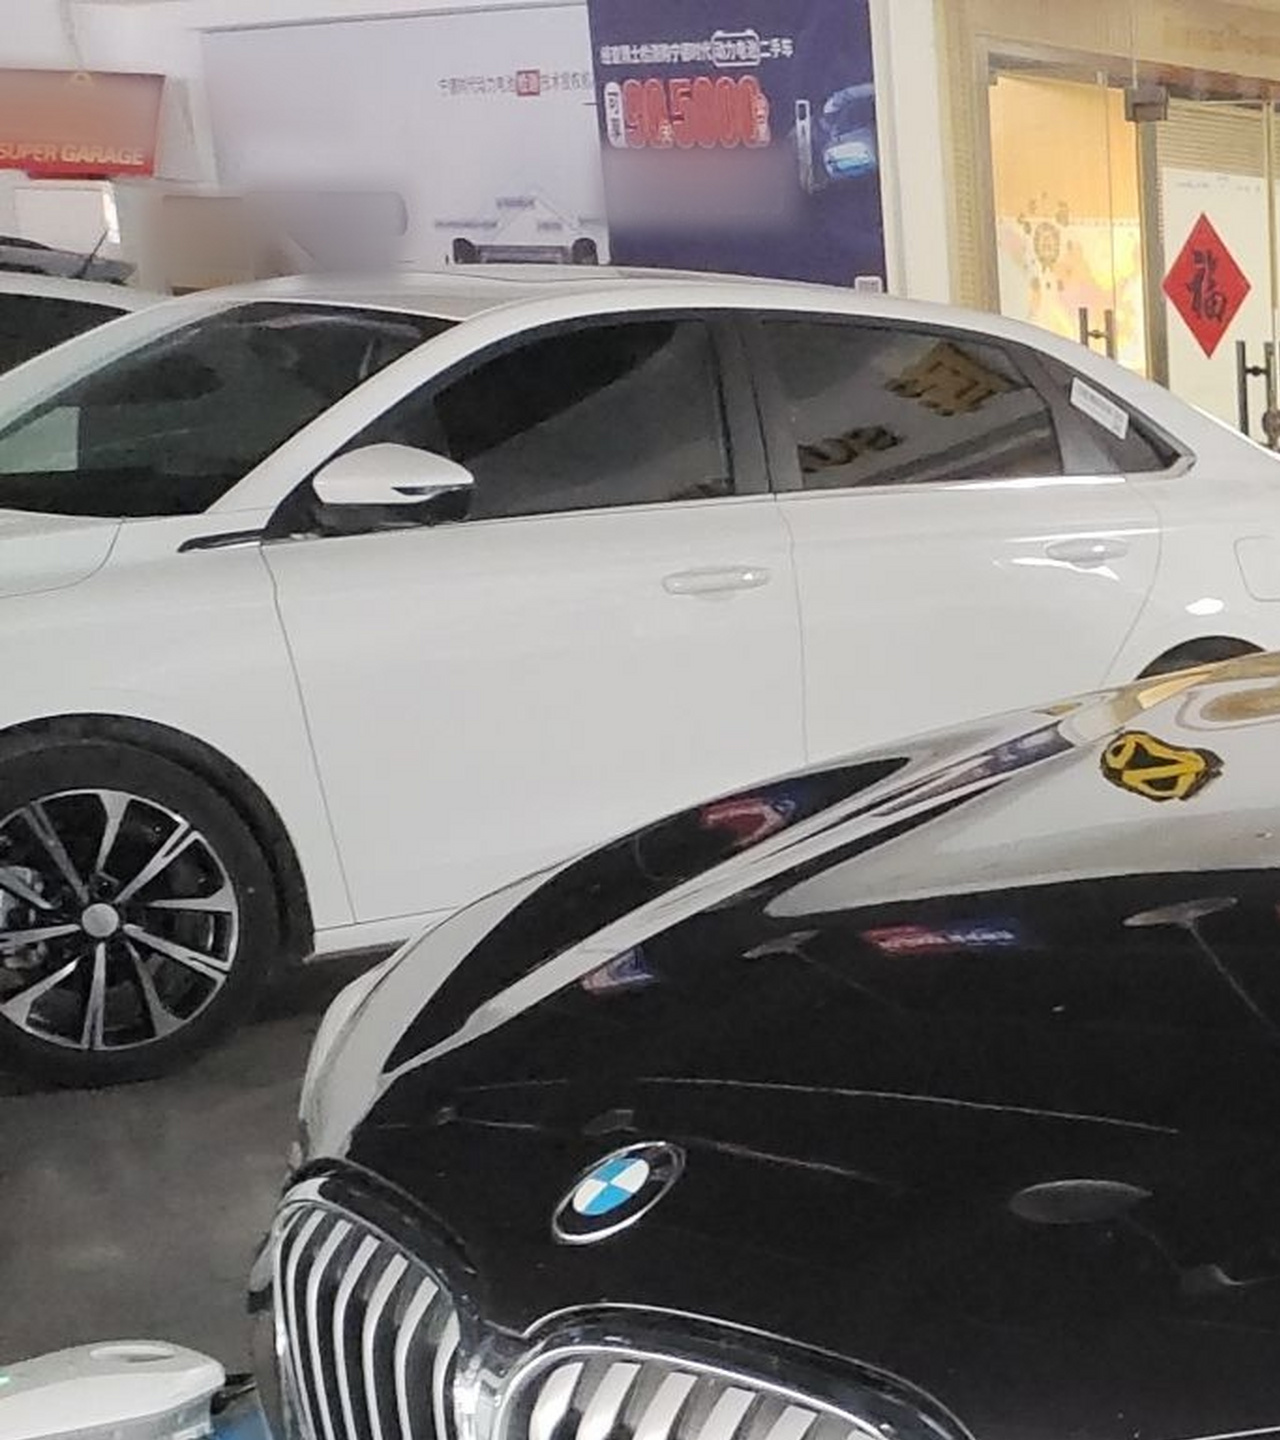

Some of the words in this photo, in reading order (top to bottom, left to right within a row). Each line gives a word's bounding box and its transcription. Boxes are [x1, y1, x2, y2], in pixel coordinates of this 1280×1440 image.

[0, 142, 57, 161] SUPER
[61, 144, 144, 165] GARAGE
[1186, 249, 1228, 322] 福
